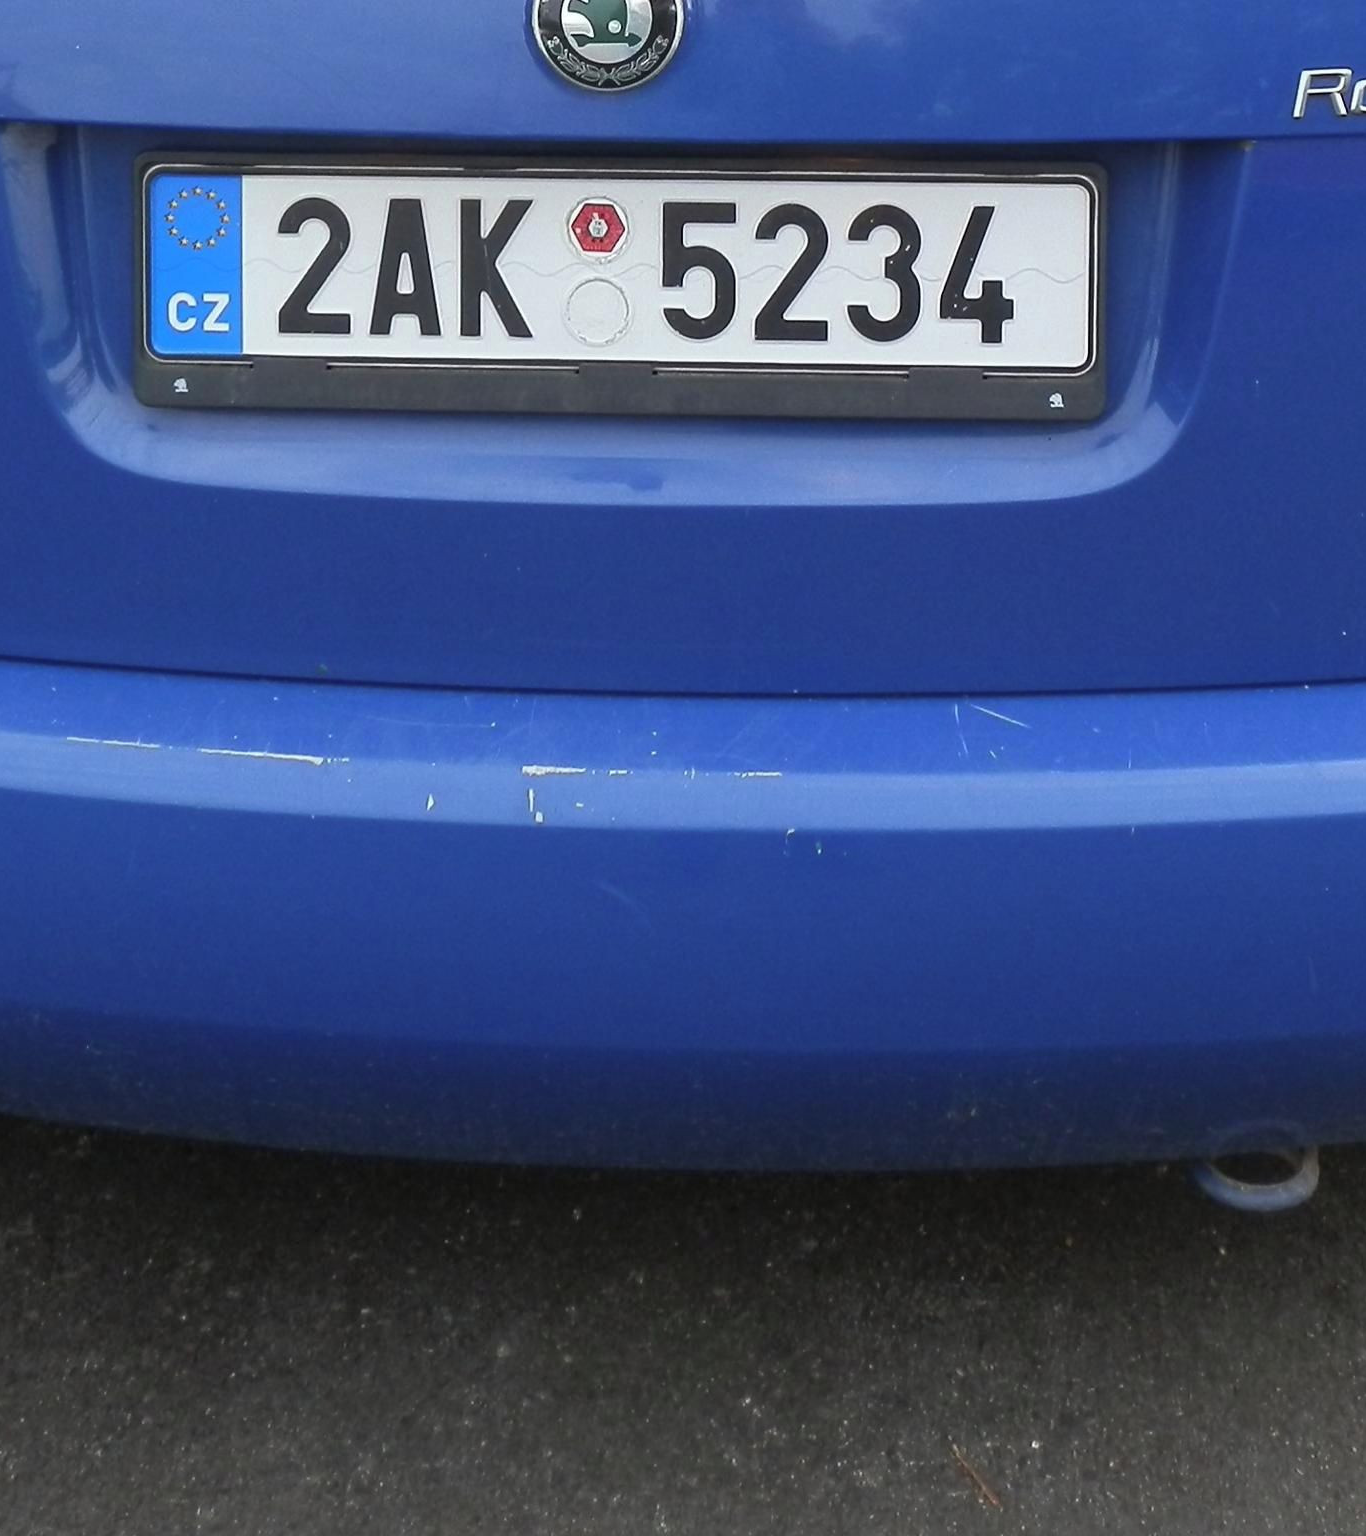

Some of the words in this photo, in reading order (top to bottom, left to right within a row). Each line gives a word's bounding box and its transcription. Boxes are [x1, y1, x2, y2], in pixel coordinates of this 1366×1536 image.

[167, 291, 231, 333] CZ
[277, 197, 534, 340] 2AK
[661, 201, 1015, 346] 5234
